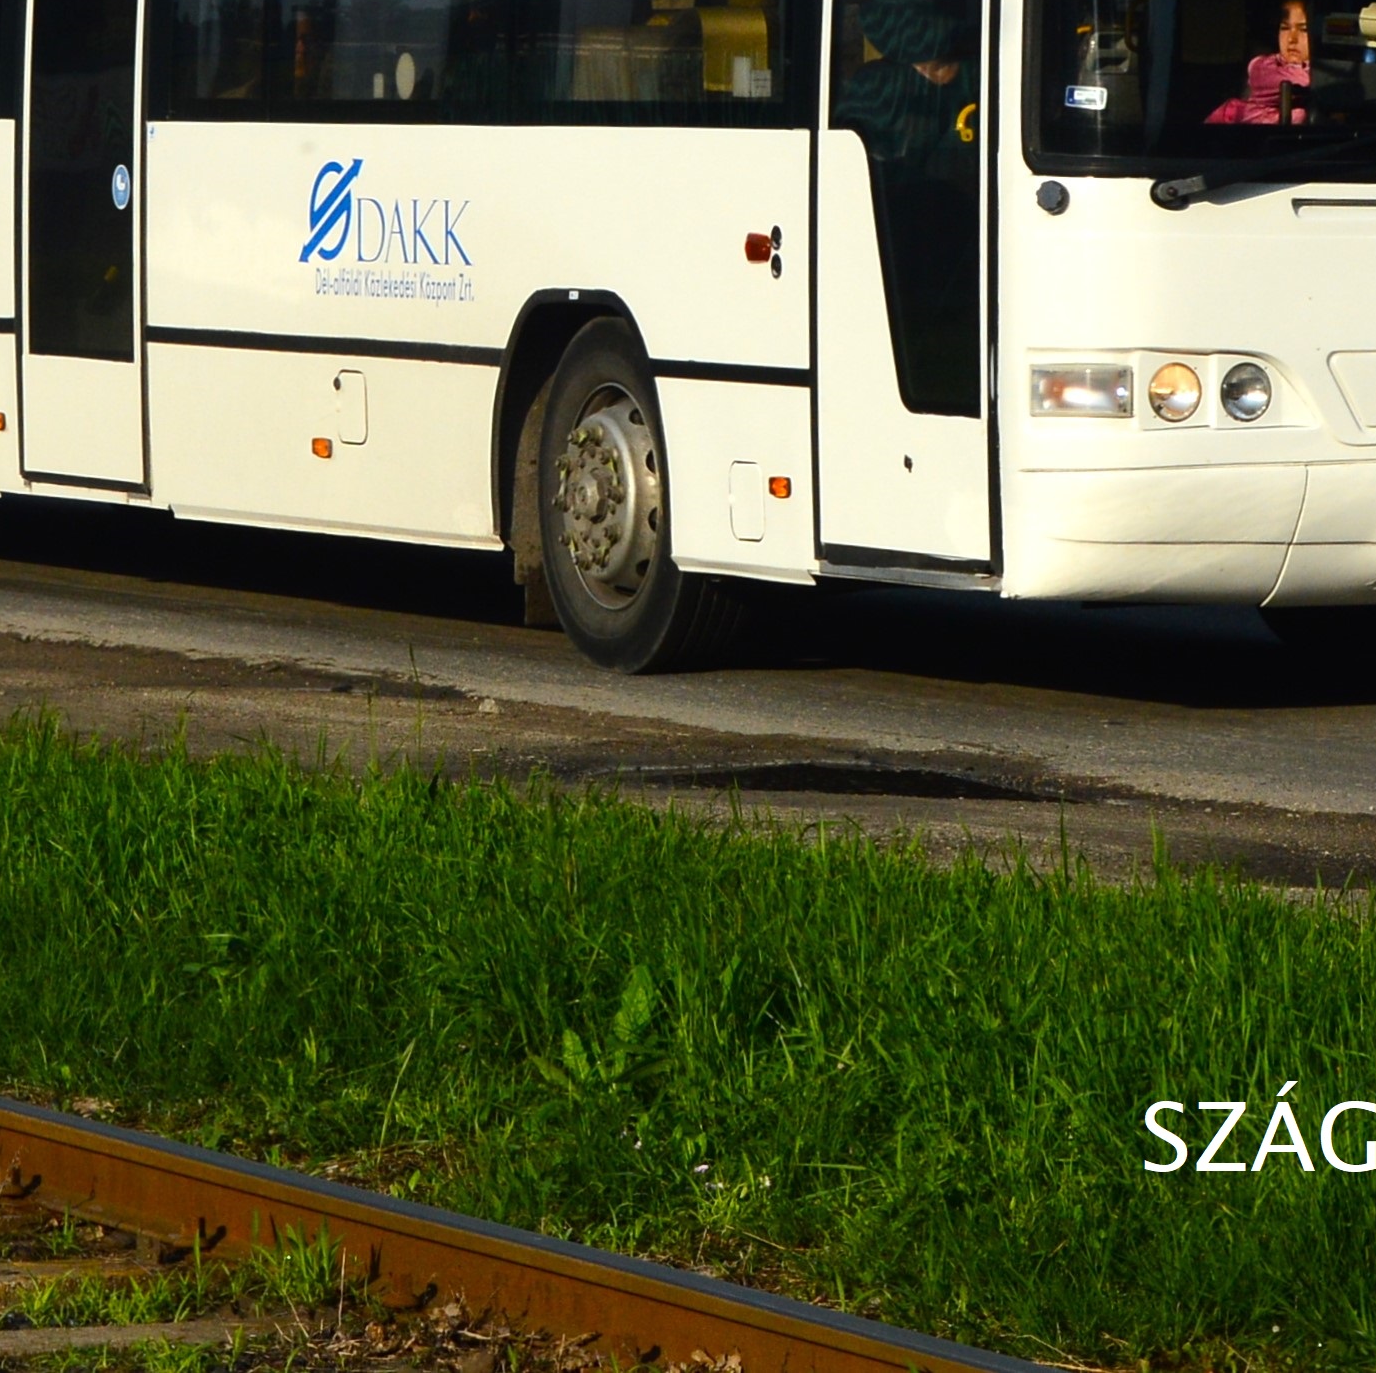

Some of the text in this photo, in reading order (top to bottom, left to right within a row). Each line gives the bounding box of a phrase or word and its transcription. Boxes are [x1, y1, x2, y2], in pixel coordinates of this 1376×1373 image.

[356, 198, 473, 266] DAKK
[364, 269, 417, 298] Közlekedési
[419, 271, 455, 307] Központ
